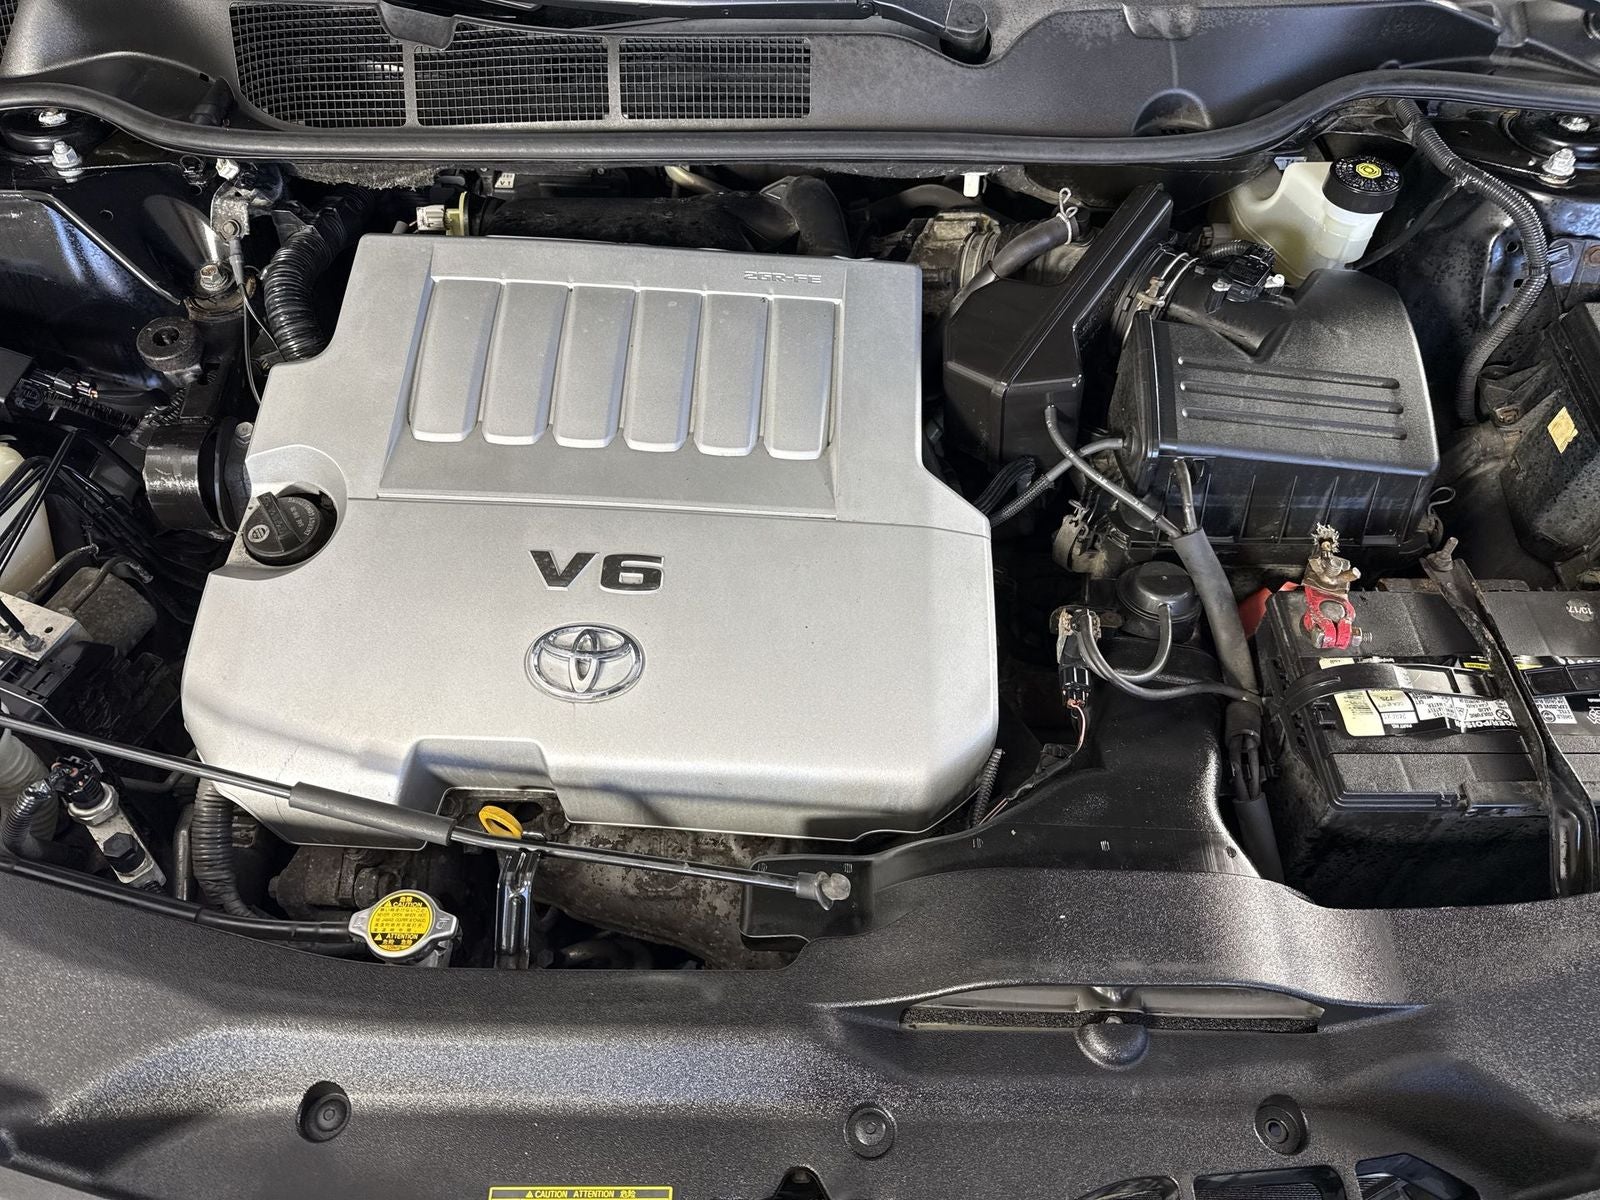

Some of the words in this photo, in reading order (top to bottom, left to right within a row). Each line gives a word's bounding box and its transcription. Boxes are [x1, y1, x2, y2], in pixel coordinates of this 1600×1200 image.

[744, 270, 822, 284] 2GR-FE
[528, 549, 665, 595] V6
[534, 1190, 568, 1198] CAUTION
[573, 1190, 615, 1198] ATTENTION
